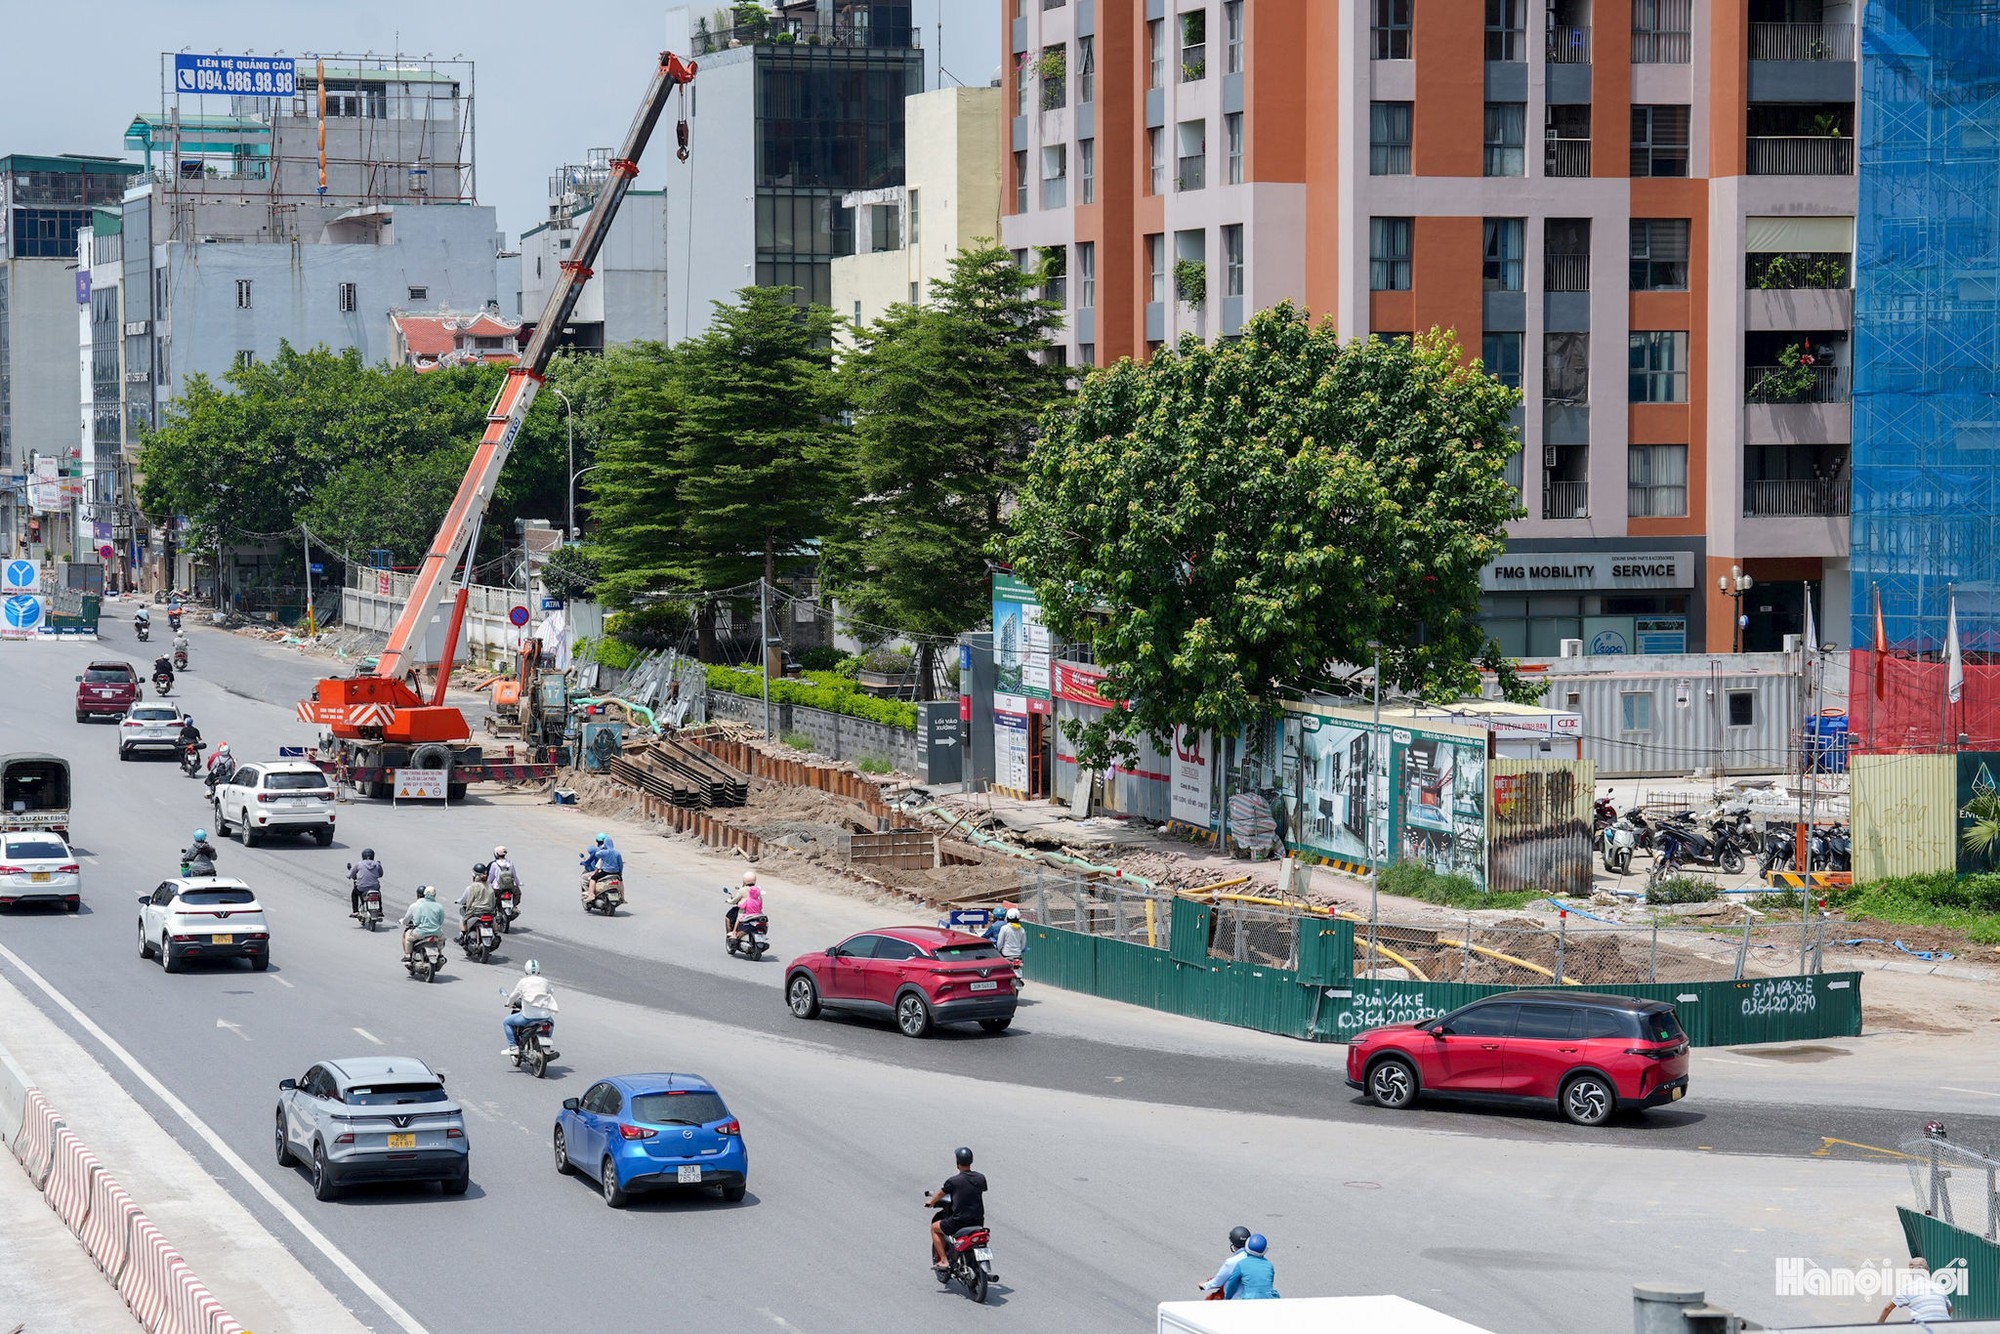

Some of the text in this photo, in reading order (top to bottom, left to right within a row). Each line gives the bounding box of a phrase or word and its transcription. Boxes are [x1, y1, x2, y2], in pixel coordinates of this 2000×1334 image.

[196, 58, 292, 70] LIÊN HỆ QUẢNG CÁO
[196, 70, 292, 92] 094.986.98.98
[503, 417, 520, 449] KATO
[1495, 566, 1594, 579] FMG MOBILITY
[1612, 564, 1675, 577] SERVICE
